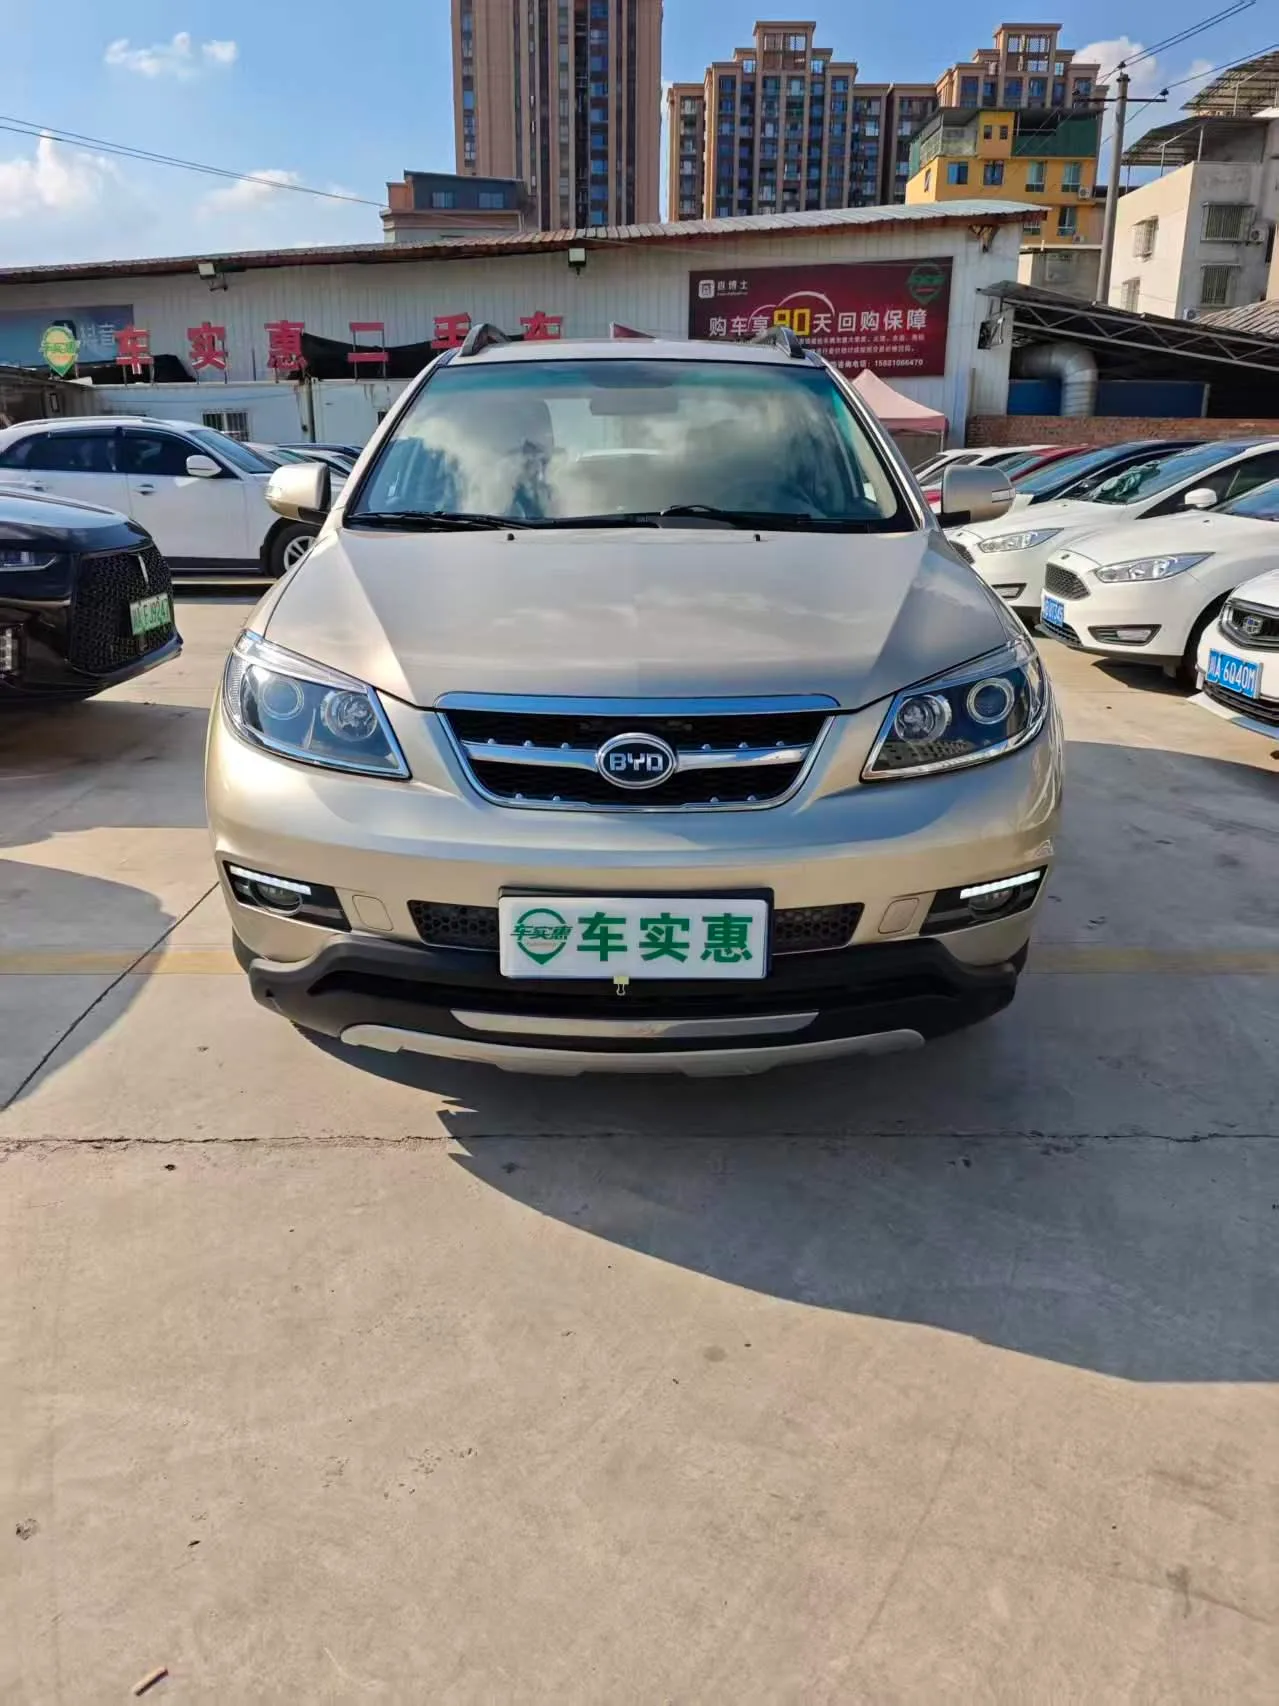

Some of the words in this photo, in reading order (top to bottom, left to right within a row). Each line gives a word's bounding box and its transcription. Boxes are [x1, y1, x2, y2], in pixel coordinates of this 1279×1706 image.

[114, 310, 565, 374] 车实惠二手车
[709, 307, 928, 337] 购车享90天回购保障
[609, 753, 663, 771] BYD
[577, 911, 753, 963] 车实惠
